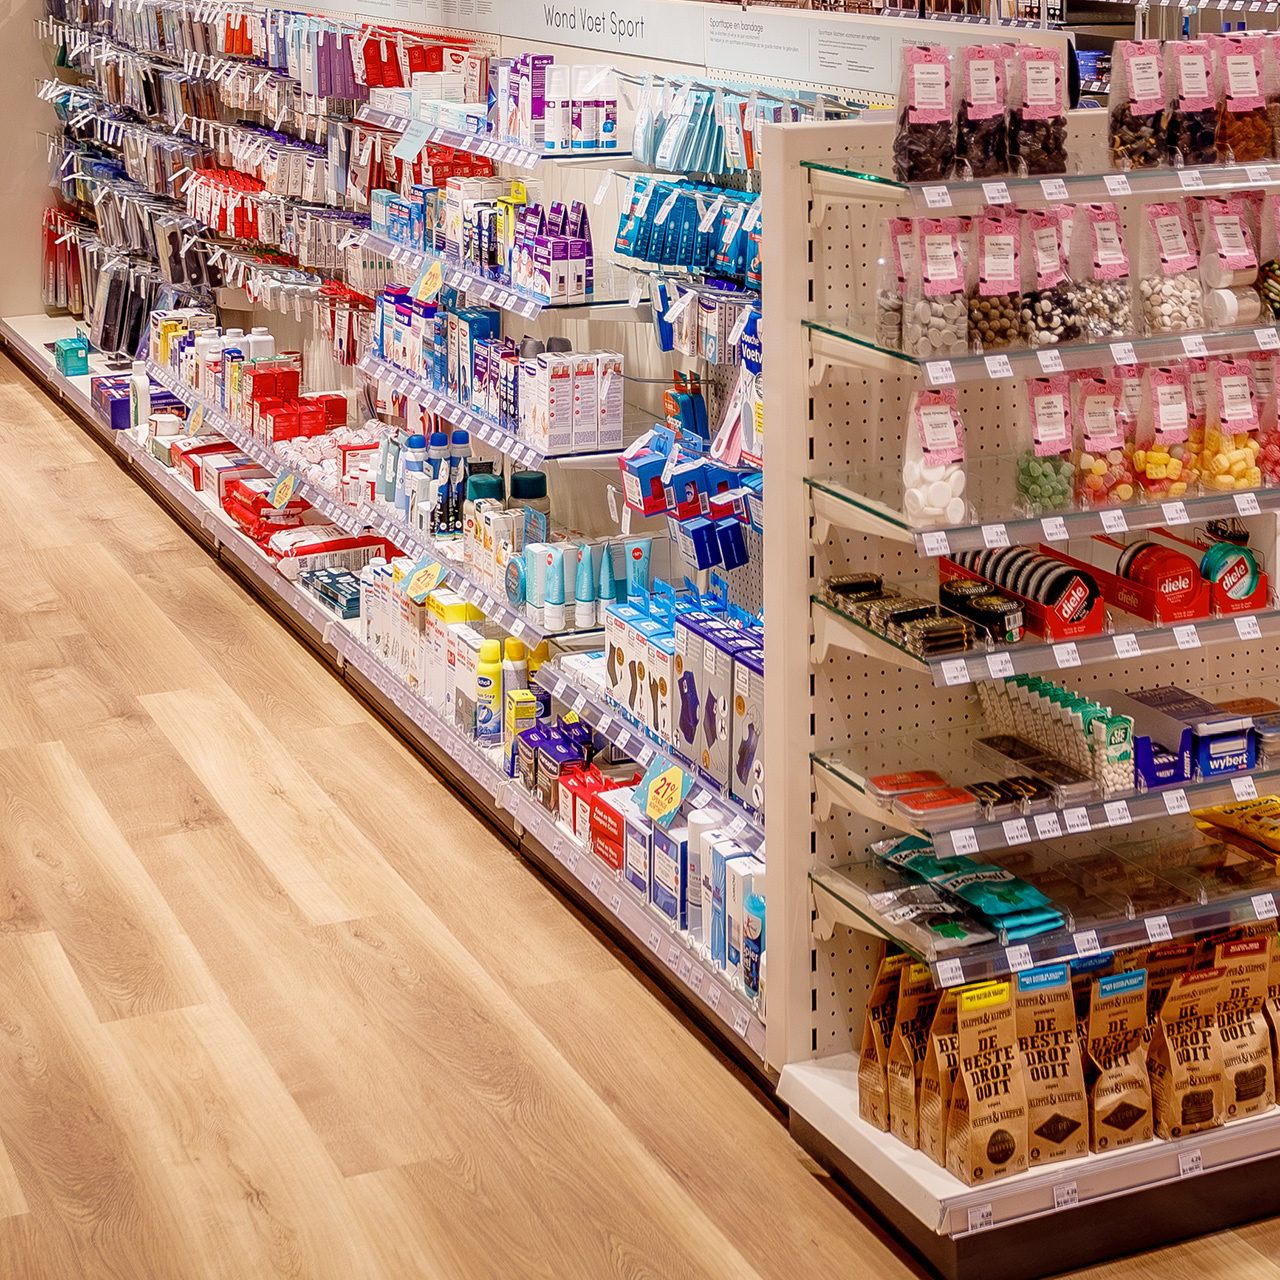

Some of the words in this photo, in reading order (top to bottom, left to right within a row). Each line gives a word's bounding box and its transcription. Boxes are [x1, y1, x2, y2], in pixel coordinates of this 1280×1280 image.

[543, 3, 578, 30] Wond
[580, 7, 607, 33] Voet
[609, 11, 645, 42] Sport
[741, 330, 760, 347] Douche
[1161, 577, 1190, 594] diele
[1223, 564, 1246, 591] diele
[1061, 585, 1086, 619] diele
[1117, 589, 1139, 608] diele
[1209, 753, 1248, 770] wybert
[653, 778, 679, 804] 21%
[1179, 1004, 1199, 1020] DE
[1217, 995, 1262, 1014] BESTE
[1034, 1018, 1057, 1034] DE
[1166, 1013, 1215, 1038] BESTE
[1218, 1007, 1255, 1029] DROP
[978, 1035, 998, 1052] DE
[1020, 1029, 1074, 1051] BESTE
[1171, 1030, 1212, 1051] DROP
[963, 1043, 1015, 1073] BESTE
[1025, 1046, 1071, 1066] DROP
[1176, 1046, 1211, 1066] OOIT
[970, 1063, 1012, 1086] DROP
[1030, 1062, 1070, 1082] OOIT
[976, 1079, 1011, 1102] OOIT
